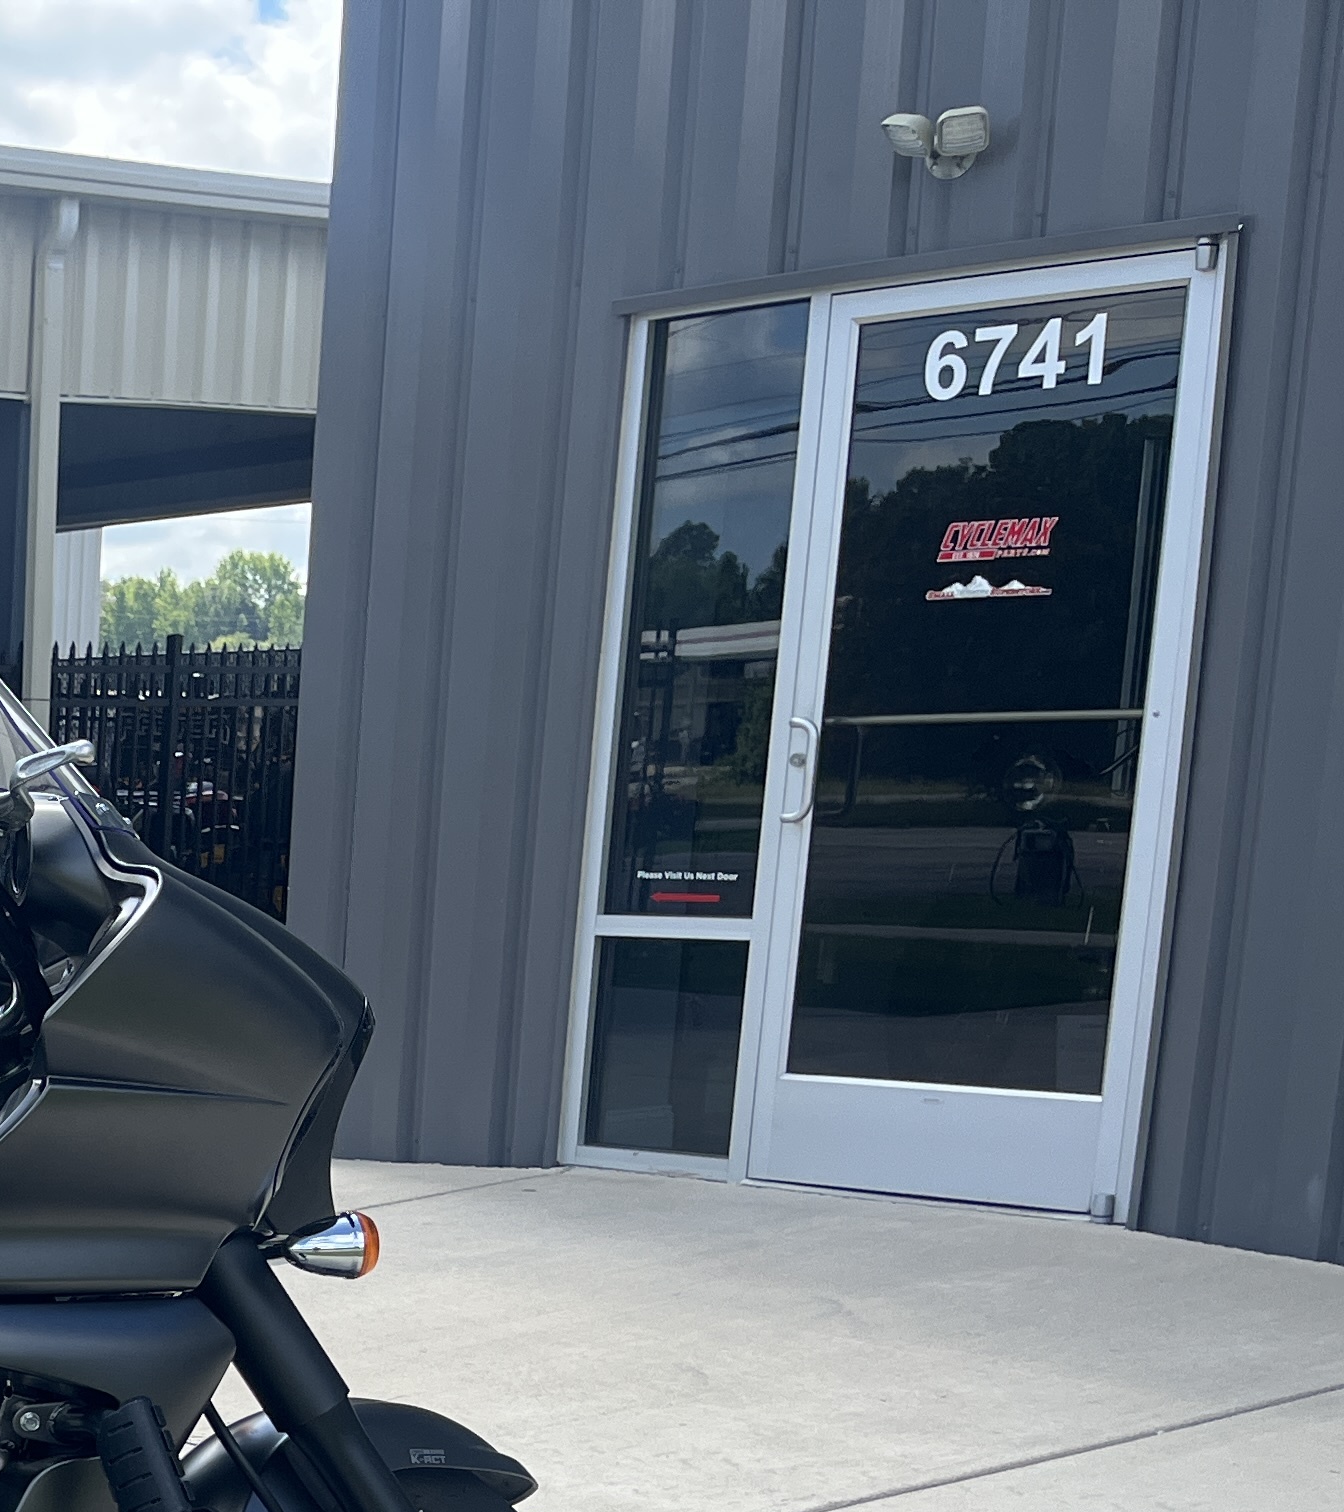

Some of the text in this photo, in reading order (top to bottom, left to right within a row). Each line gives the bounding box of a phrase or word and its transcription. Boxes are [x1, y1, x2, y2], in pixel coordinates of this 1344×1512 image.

[924, 312, 1108, 401] 6741
[940, 516, 1059, 551] CYCLEMAX
[637, 870, 739, 881] Please Visit Us Next Door
